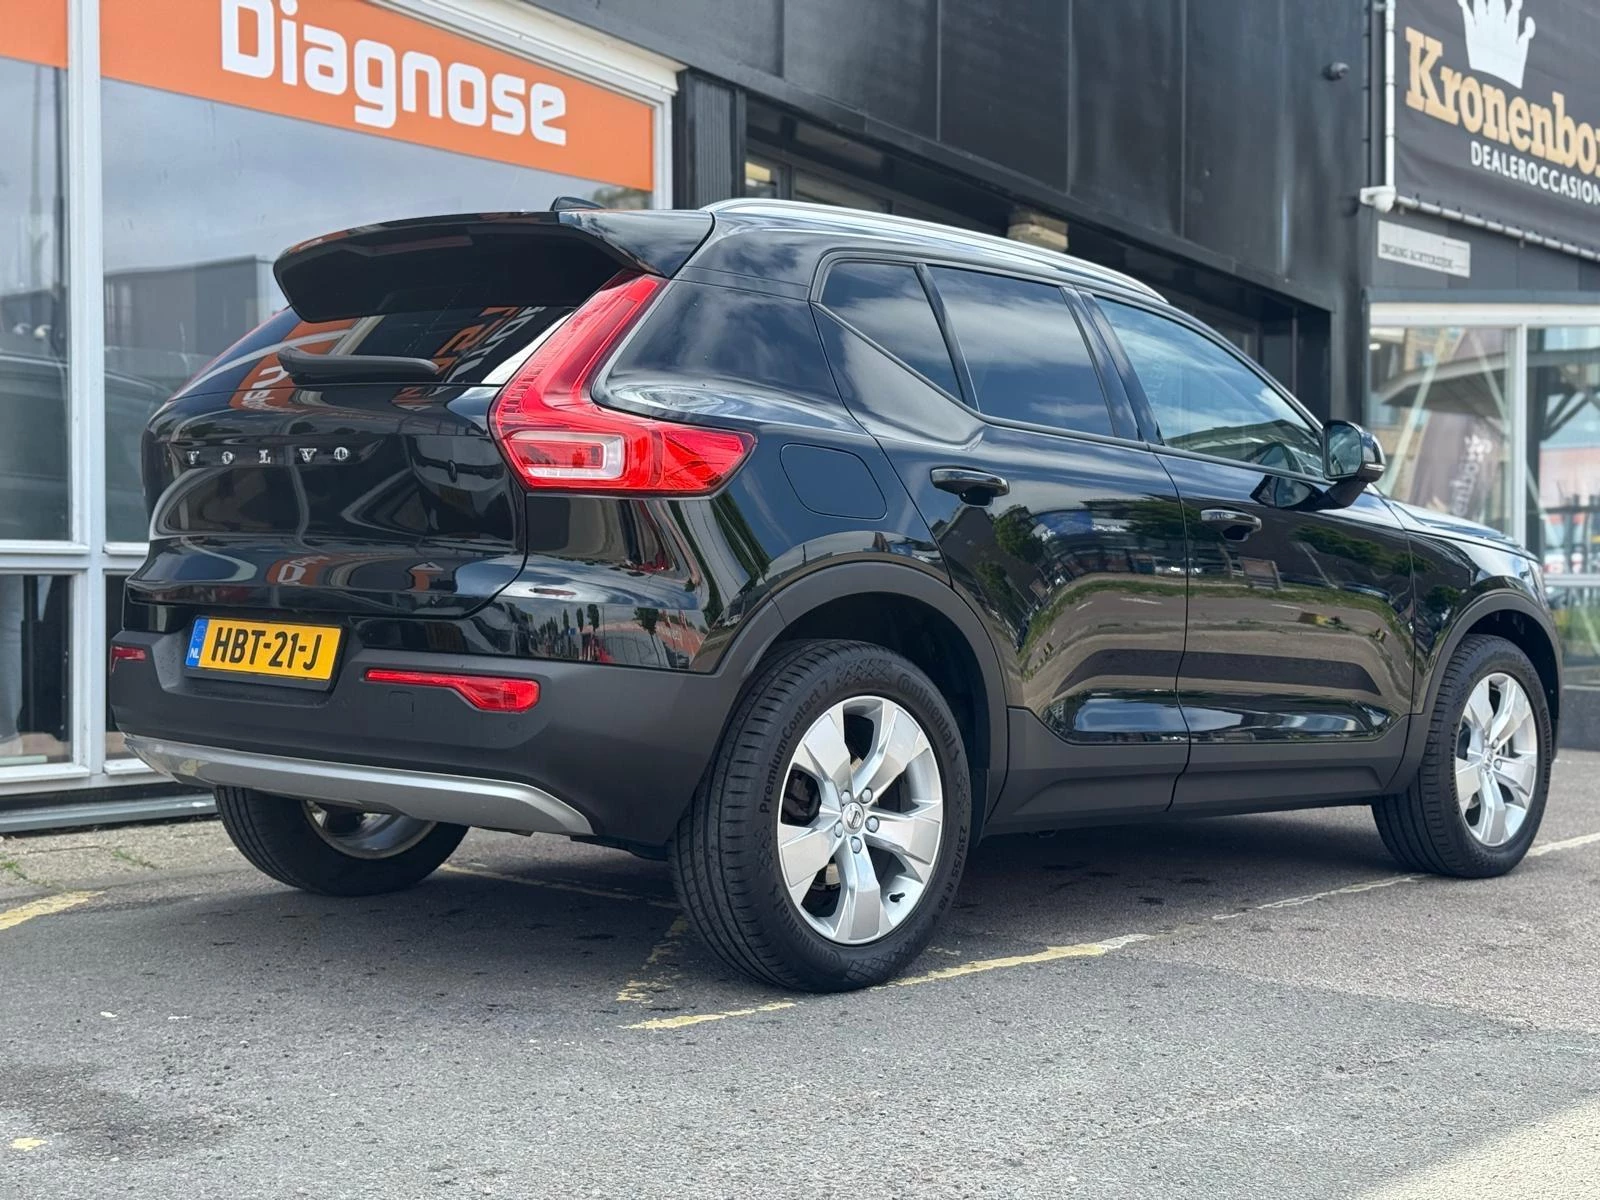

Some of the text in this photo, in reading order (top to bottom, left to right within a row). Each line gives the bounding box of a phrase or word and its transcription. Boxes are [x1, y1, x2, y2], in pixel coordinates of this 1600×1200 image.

[221, 0, 566, 146] Diagnose
[1405, 26, 1600, 179] Kronenbo
[186, 446, 349, 465] VOLVO
[189, 648, 200, 659] NL
[211, 626, 322, 671] HBT-21-J
[897, 672, 957, 750] Continental
[759, 688, 821, 814] PremiumContact
